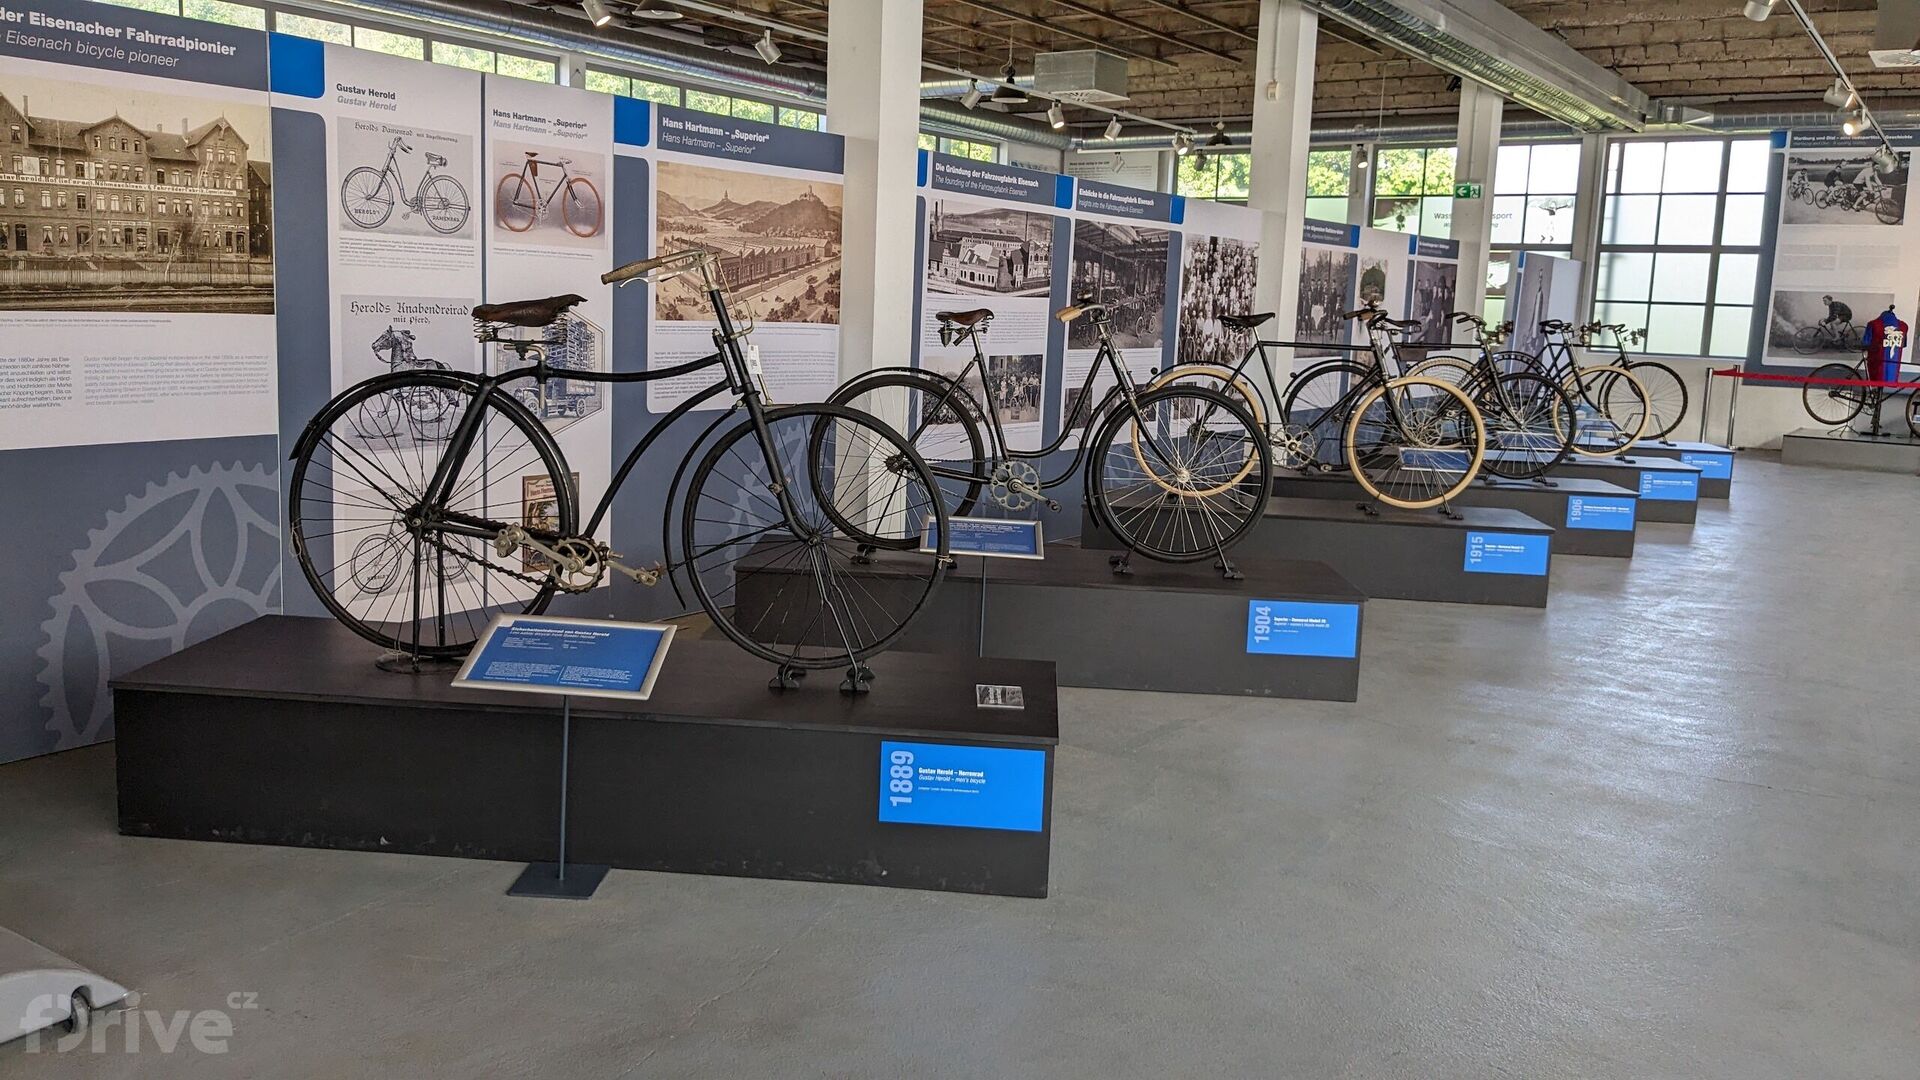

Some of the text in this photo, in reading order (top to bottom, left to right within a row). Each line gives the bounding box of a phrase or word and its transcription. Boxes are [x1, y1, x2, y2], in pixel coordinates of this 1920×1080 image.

[29, 11, 122, 38] Eisenacher
[126, 27, 236, 56] Fahrradpionier
[6, 30, 179, 68] Eisenach bicycle pioneer
[336, 83, 396, 100] Gustav Herold
[337, 95, 397, 112] Gustav Herold
[493, 109, 511, 118] Hans
[513, 112, 546, 124] Hartmann
[493, 120, 511, 129] Hans
[513, 123, 547, 134] Hartmann
[662, 117, 683, 130] Hans
[685, 120, 723, 137] Hartmann
[662, 133, 681, 144] Hans
[682, 135, 716, 150] Hartmann
[935, 162, 1039, 188] Die Gründung der Fahrzeugfabrik Eisenach
[935, 175, 1028, 197] The founding of the Fahrzeugfabrik Eisenach
[350, 301, 469, 316] Herolds Knabendreirad
[393, 315, 406, 323] mit
[1470, 536, 1483, 564] 1915
[1254, 606, 1271, 643] 1904
[890, 750, 914, 806] 1889
[919, 767, 936, 775] Gustav
